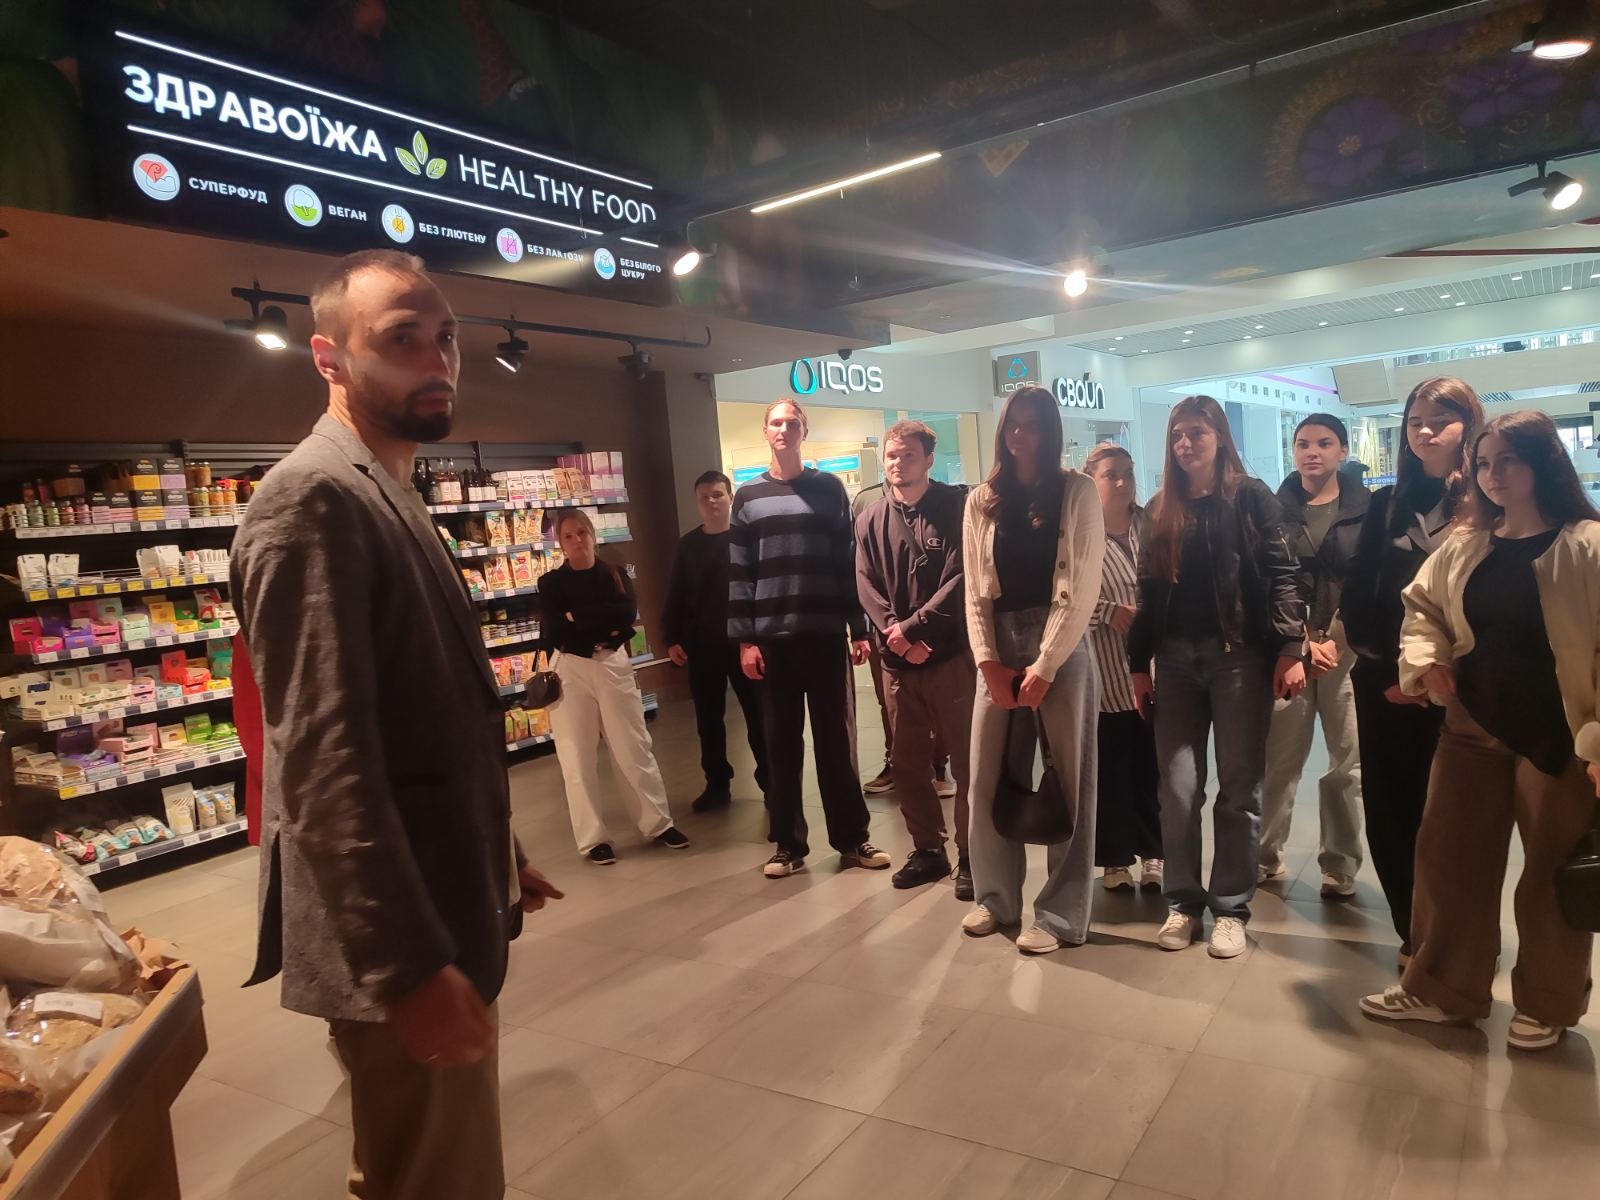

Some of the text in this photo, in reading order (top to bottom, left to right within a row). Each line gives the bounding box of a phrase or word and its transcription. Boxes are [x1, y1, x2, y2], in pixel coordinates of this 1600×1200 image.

[122, 64, 388, 163] ЗДРАВОЇЖА
[188, 176, 269, 204] СУПЕРФУД
[458, 153, 584, 210] HEALTHY
[327, 203, 368, 222] ВЕГАН
[418, 222, 487, 244] БЕЗ ГЛЮТЕНУ
[526, 243, 545, 255] БЕЗ
[619, 257, 662, 273] БЕЗ БІЛОГО
[620, 268, 646, 280] ЦУКРУ
[820, 360, 884, 395] IQOS
